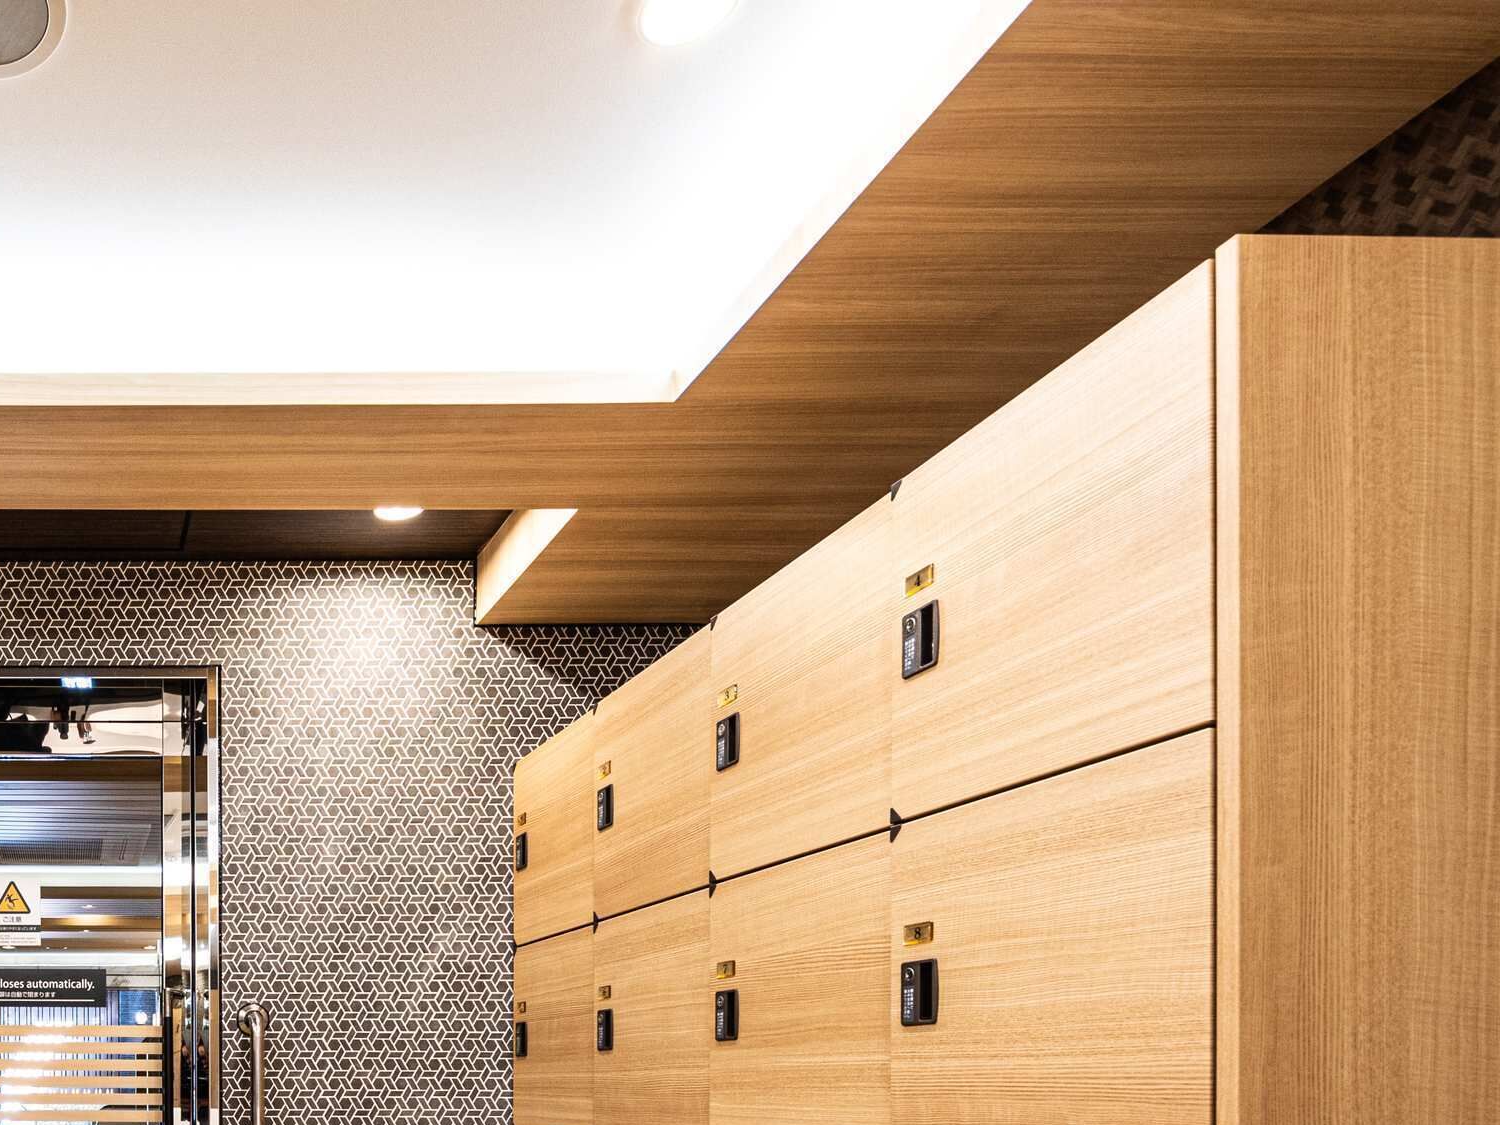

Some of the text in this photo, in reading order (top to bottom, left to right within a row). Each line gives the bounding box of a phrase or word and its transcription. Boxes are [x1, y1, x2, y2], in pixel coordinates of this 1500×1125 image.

[914, 926, 921, 941] 8
[723, 963, 729, 975] 7
[26, 977, 96, 992] automatically.
